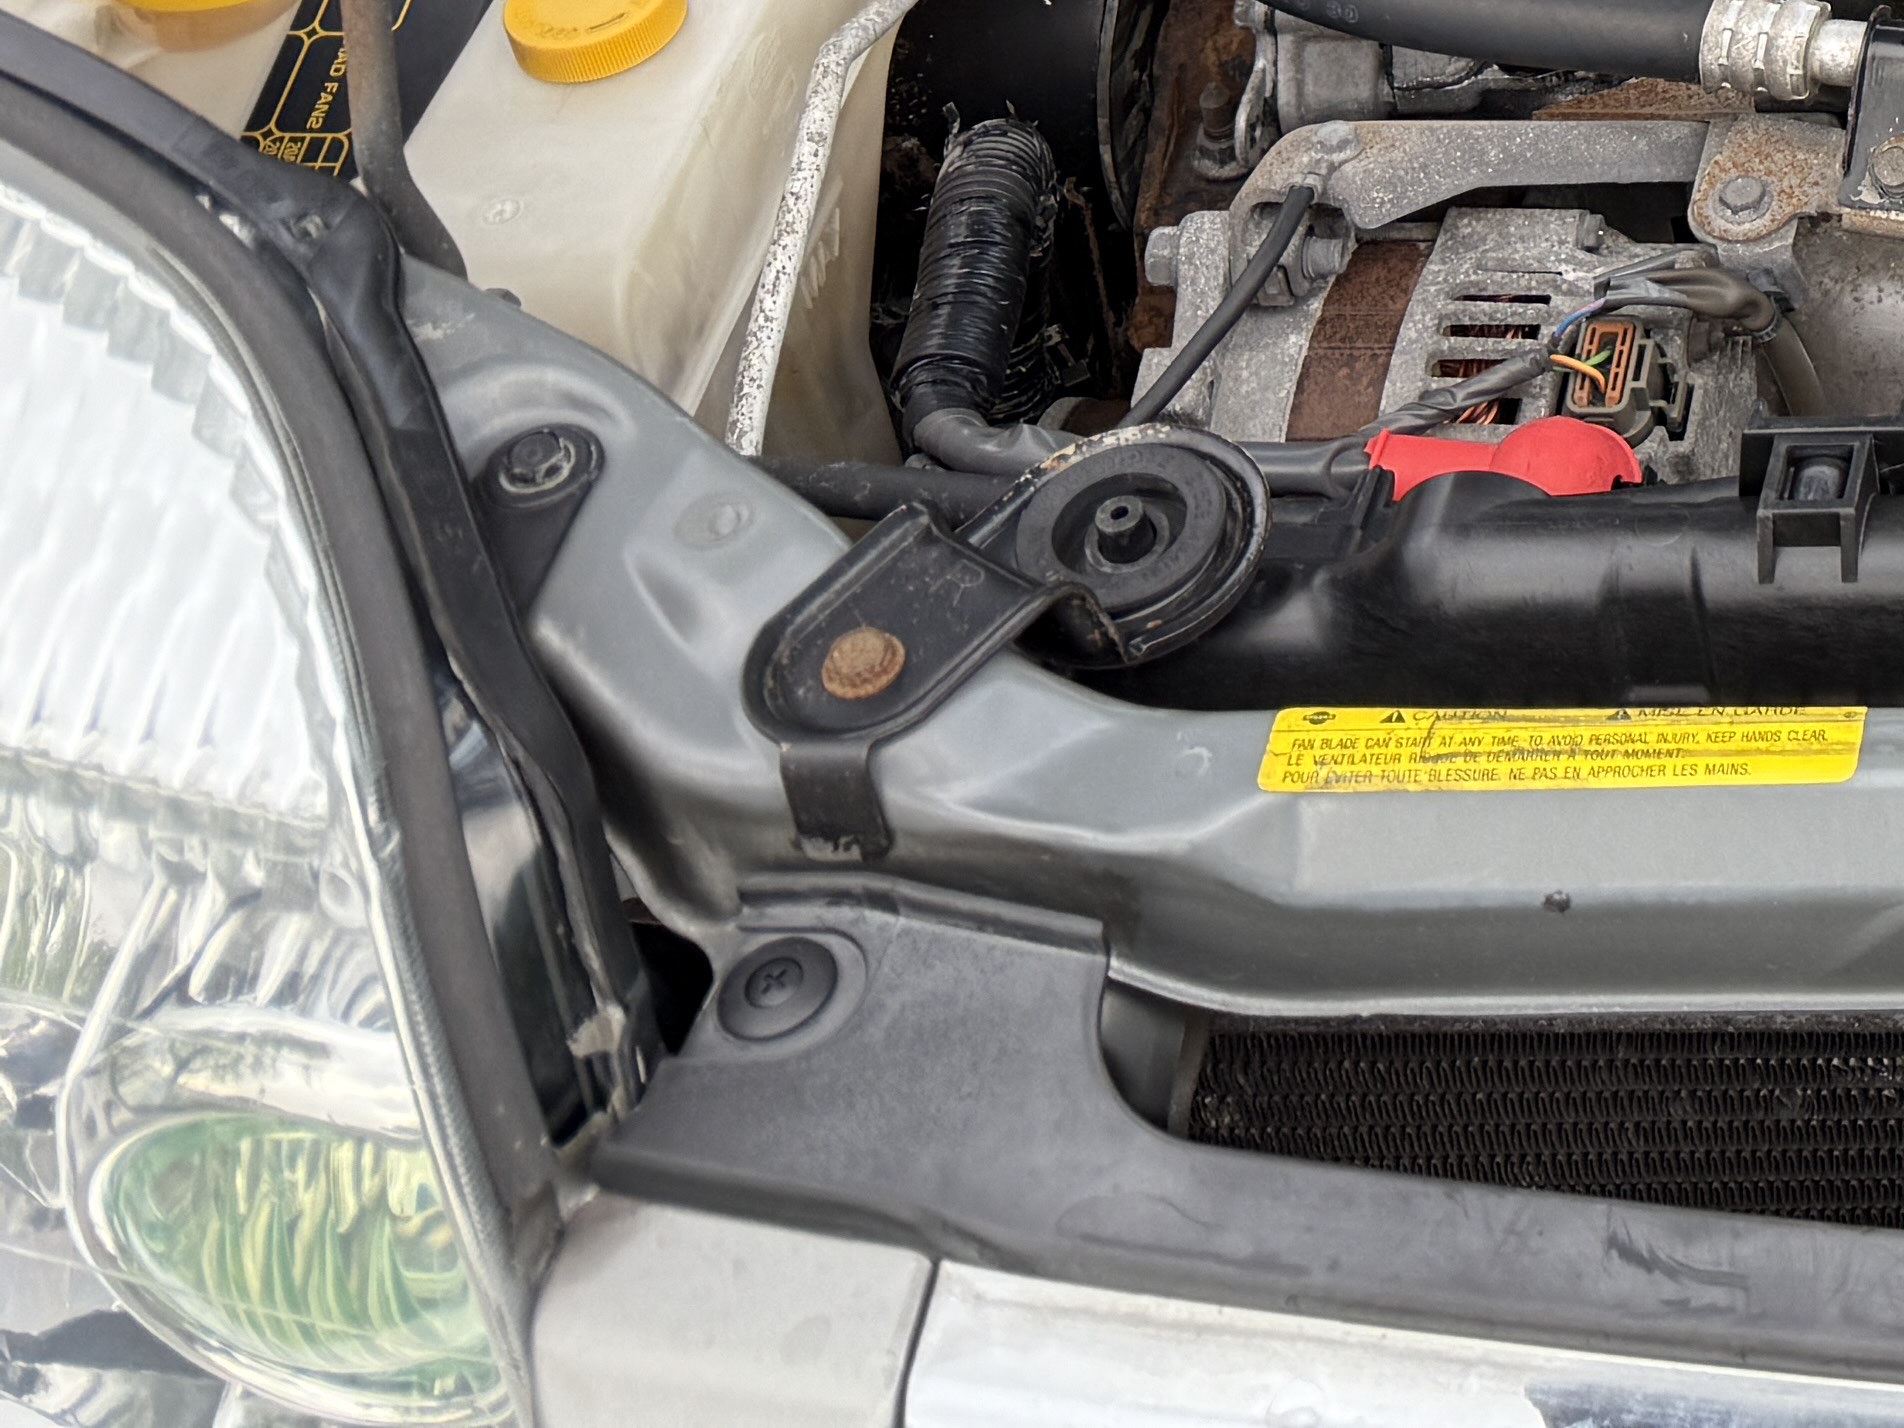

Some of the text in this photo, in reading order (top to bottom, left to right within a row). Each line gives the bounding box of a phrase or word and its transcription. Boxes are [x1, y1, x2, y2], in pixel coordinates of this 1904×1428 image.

[305, 81, 340, 131] FAN2
[1320, 736, 1361, 751] BLADE
[1365, 736, 1391, 750] CAN
[1438, 735, 1455, 749] AT
[1457, 734, 1486, 749] ANY
[1588, 731, 1650, 745] PERSONAL
[1705, 730, 1737, 744] KEEP
[1740, 729, 1782, 744] HANDS
[1286, 753, 1305, 767] LE
[1281, 769, 1320, 784] POUR
[1379, 768, 1424, 783] TOUTE
[1508, 767, 1527, 782] NE
[1530, 766, 1558, 781] PAS
[1563, 765, 1582, 780] EN
[1586, 763, 1668, 779] APPROCHER
[1671, 763, 1699, 778] LES
